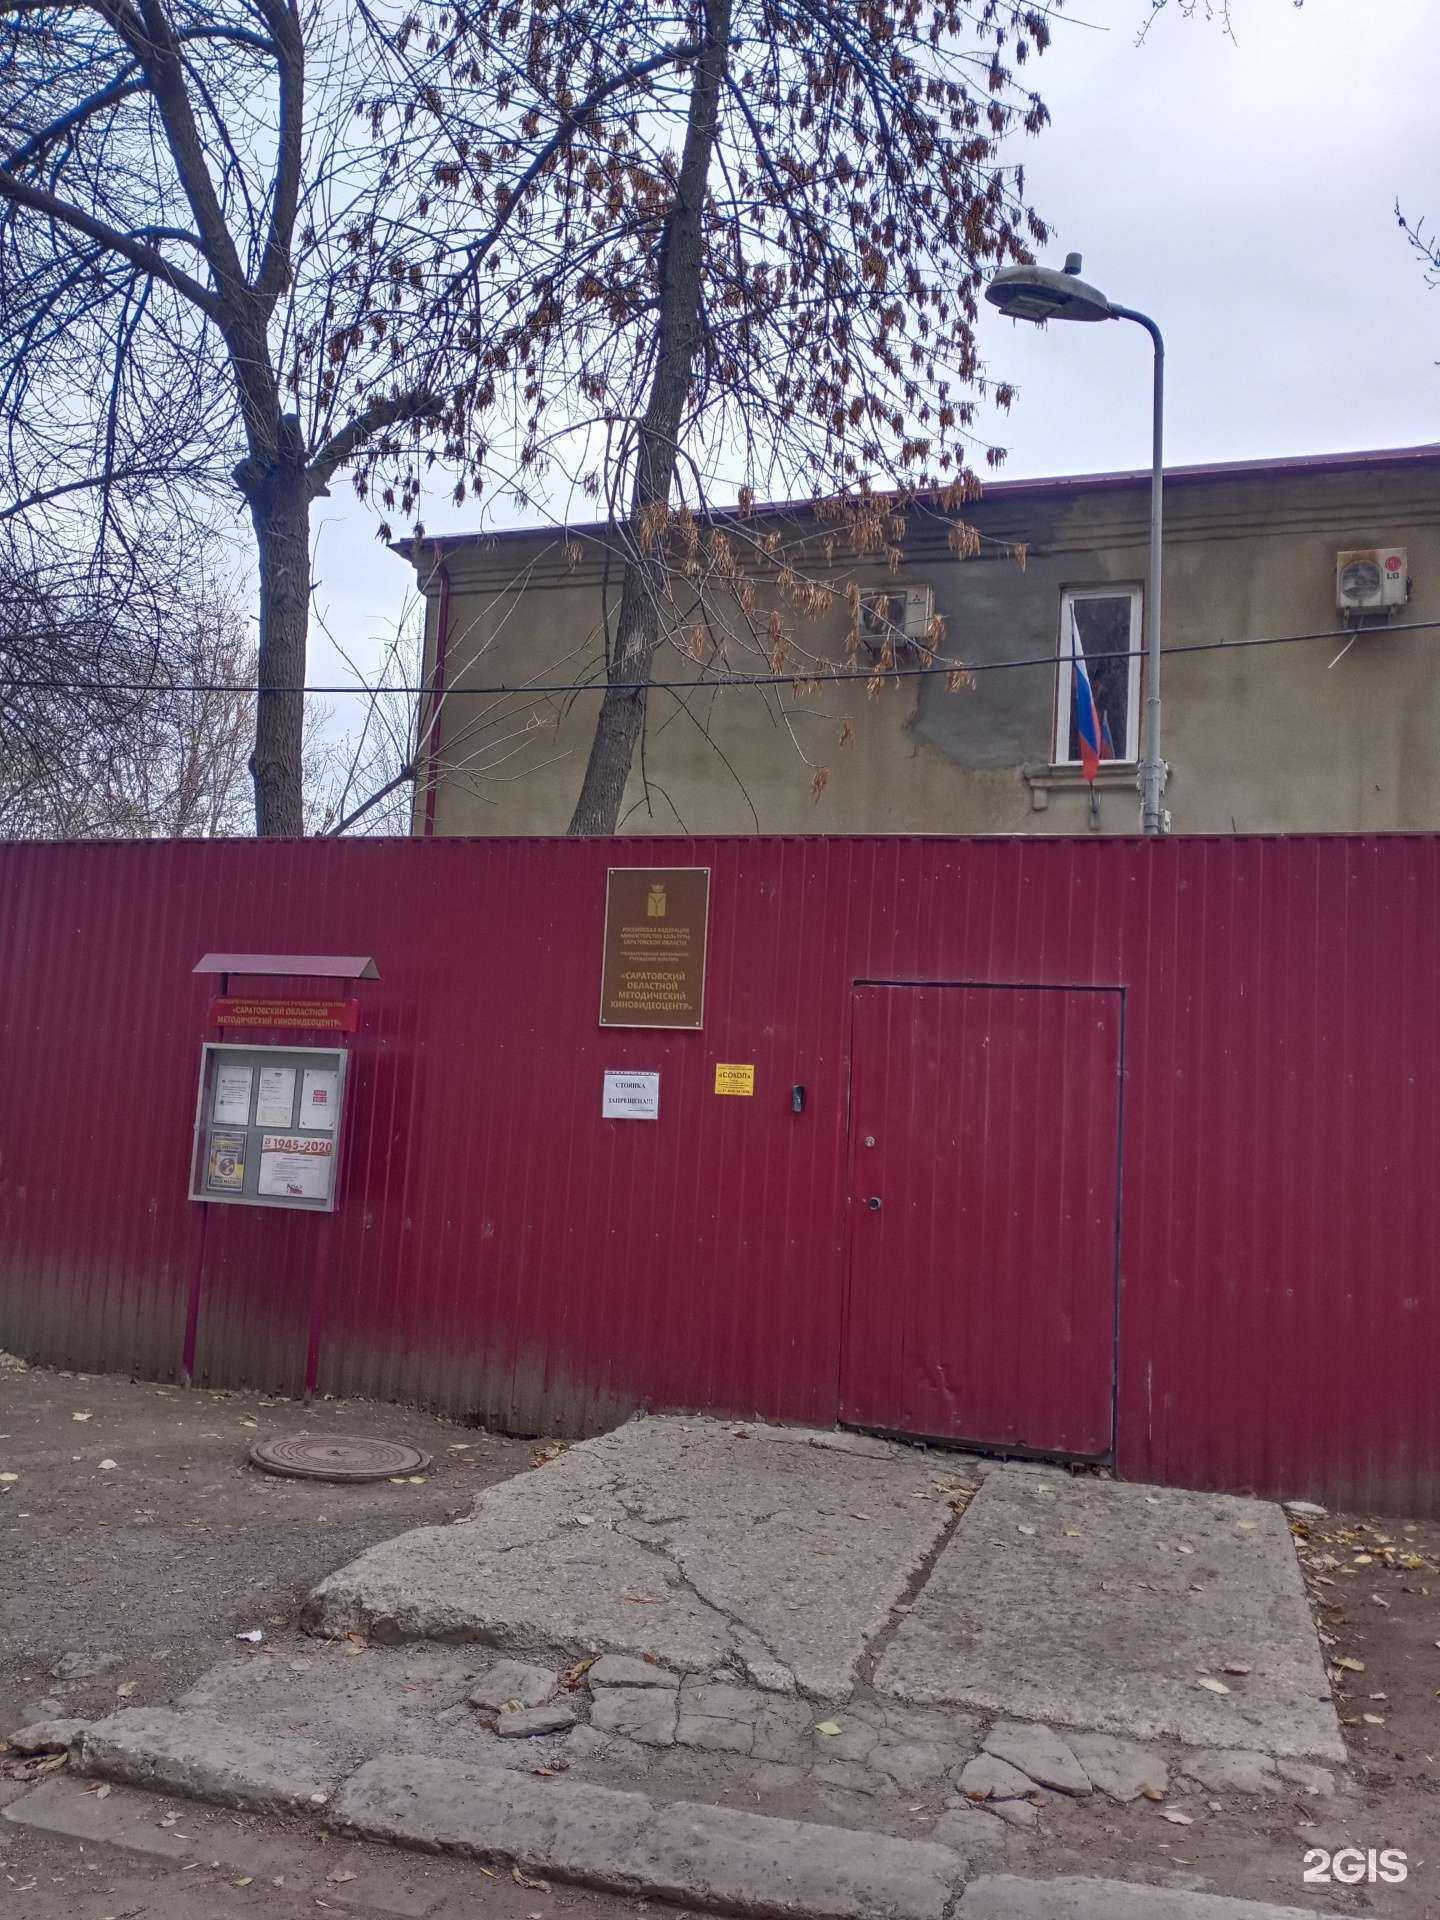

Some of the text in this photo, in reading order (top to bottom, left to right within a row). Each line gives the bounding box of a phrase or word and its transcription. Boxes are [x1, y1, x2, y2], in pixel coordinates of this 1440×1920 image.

[1386, 572, 1400, 580] LG
[627, 981, 679, 990] ОБЛАСТНОЙ
[618, 991, 687, 1001] МЕТОДИЧЕСКИЙ
[273, 1138, 333, 1152] 1945-2020
